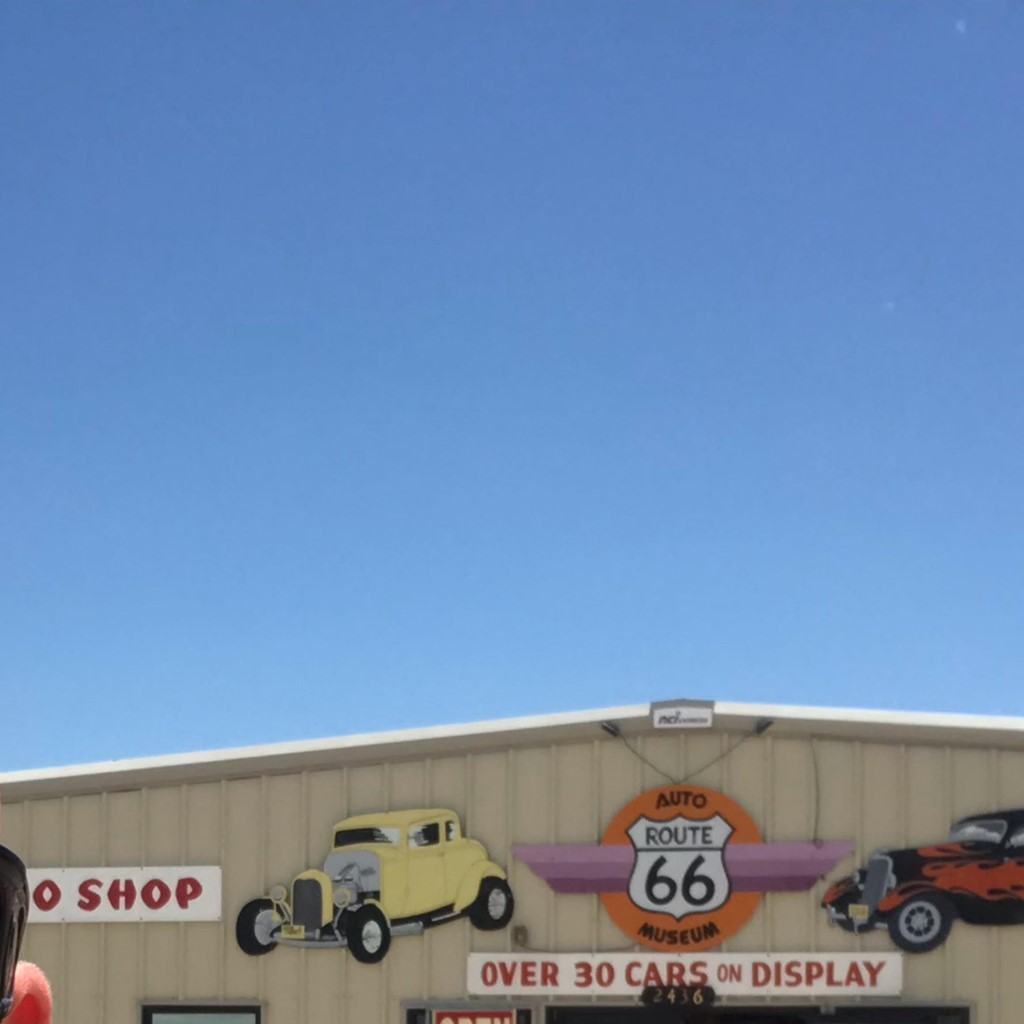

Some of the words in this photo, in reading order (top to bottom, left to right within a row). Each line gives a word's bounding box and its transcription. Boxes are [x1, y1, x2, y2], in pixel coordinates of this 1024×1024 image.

[655, 790, 708, 810] AUTO
[645, 826, 713, 846] ROUTE
[645, 854, 716, 907] 66
[77, 877, 203, 912] SHOP
[637, 920, 721, 946] MUSEUM
[481, 961, 560, 987] OVER
[574, 961, 616, 988] 30
[624, 961, 709, 988] CARS
[717, 964, 742, 983] ON
[751, 961, 886, 987] DISPLAY
